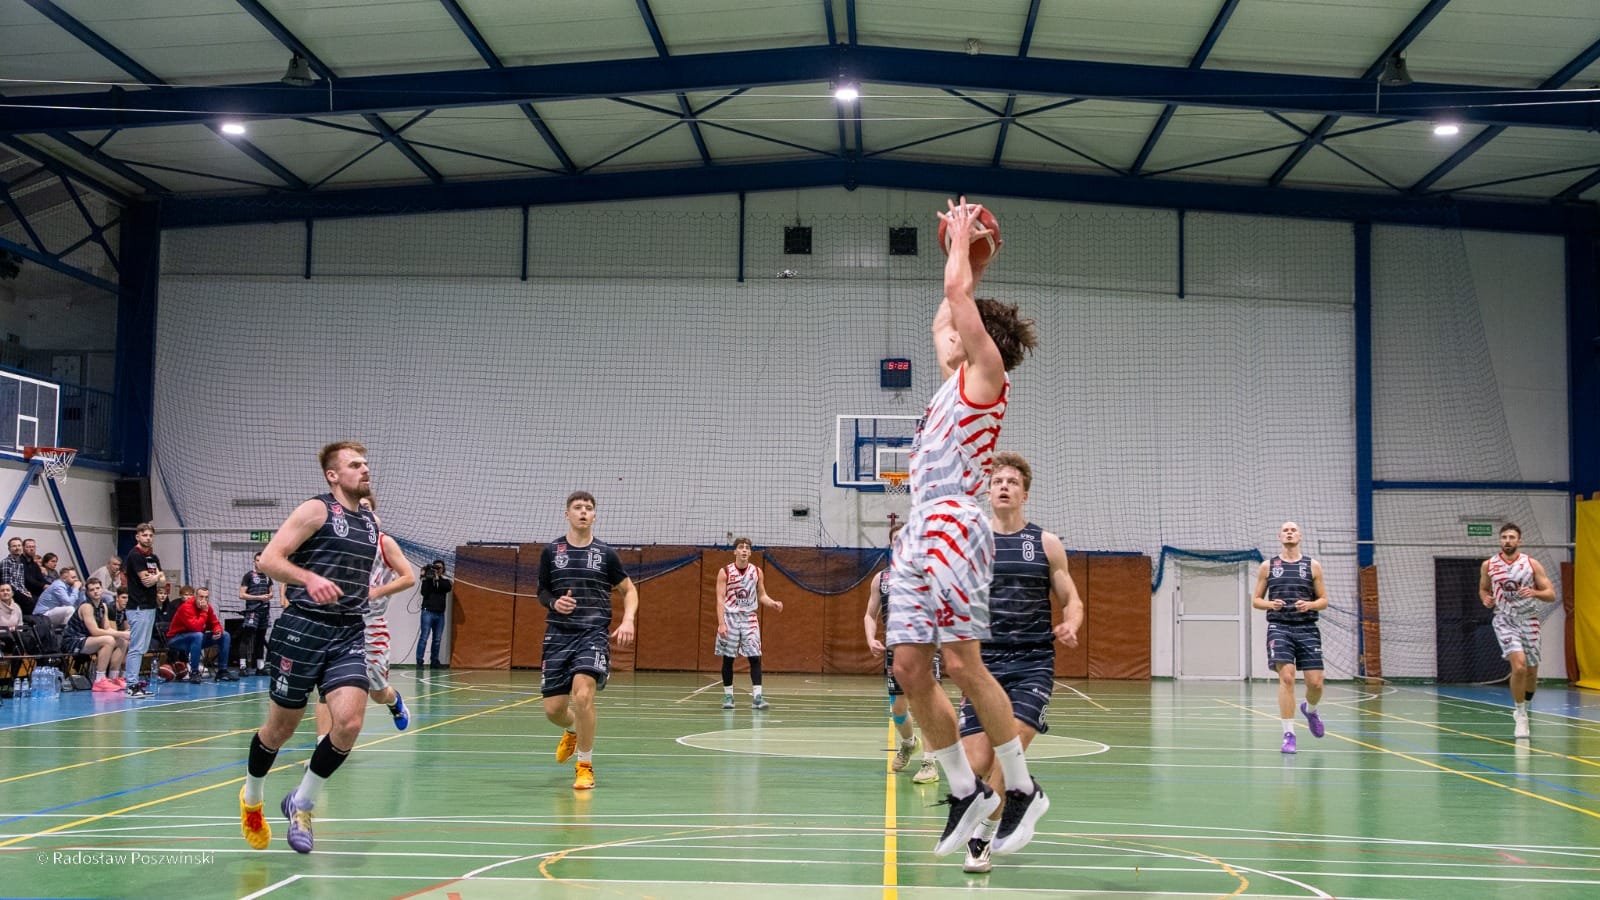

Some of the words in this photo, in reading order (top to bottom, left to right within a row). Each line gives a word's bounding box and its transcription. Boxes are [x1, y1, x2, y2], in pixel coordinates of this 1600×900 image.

[888, 361, 909, 370] 5:22
[366, 522, 377, 544] 3
[587, 551, 602, 570] 12
[1022, 540, 1035, 562] 8
[935, 606, 955, 627] 22
[593, 651, 607, 671] 12
